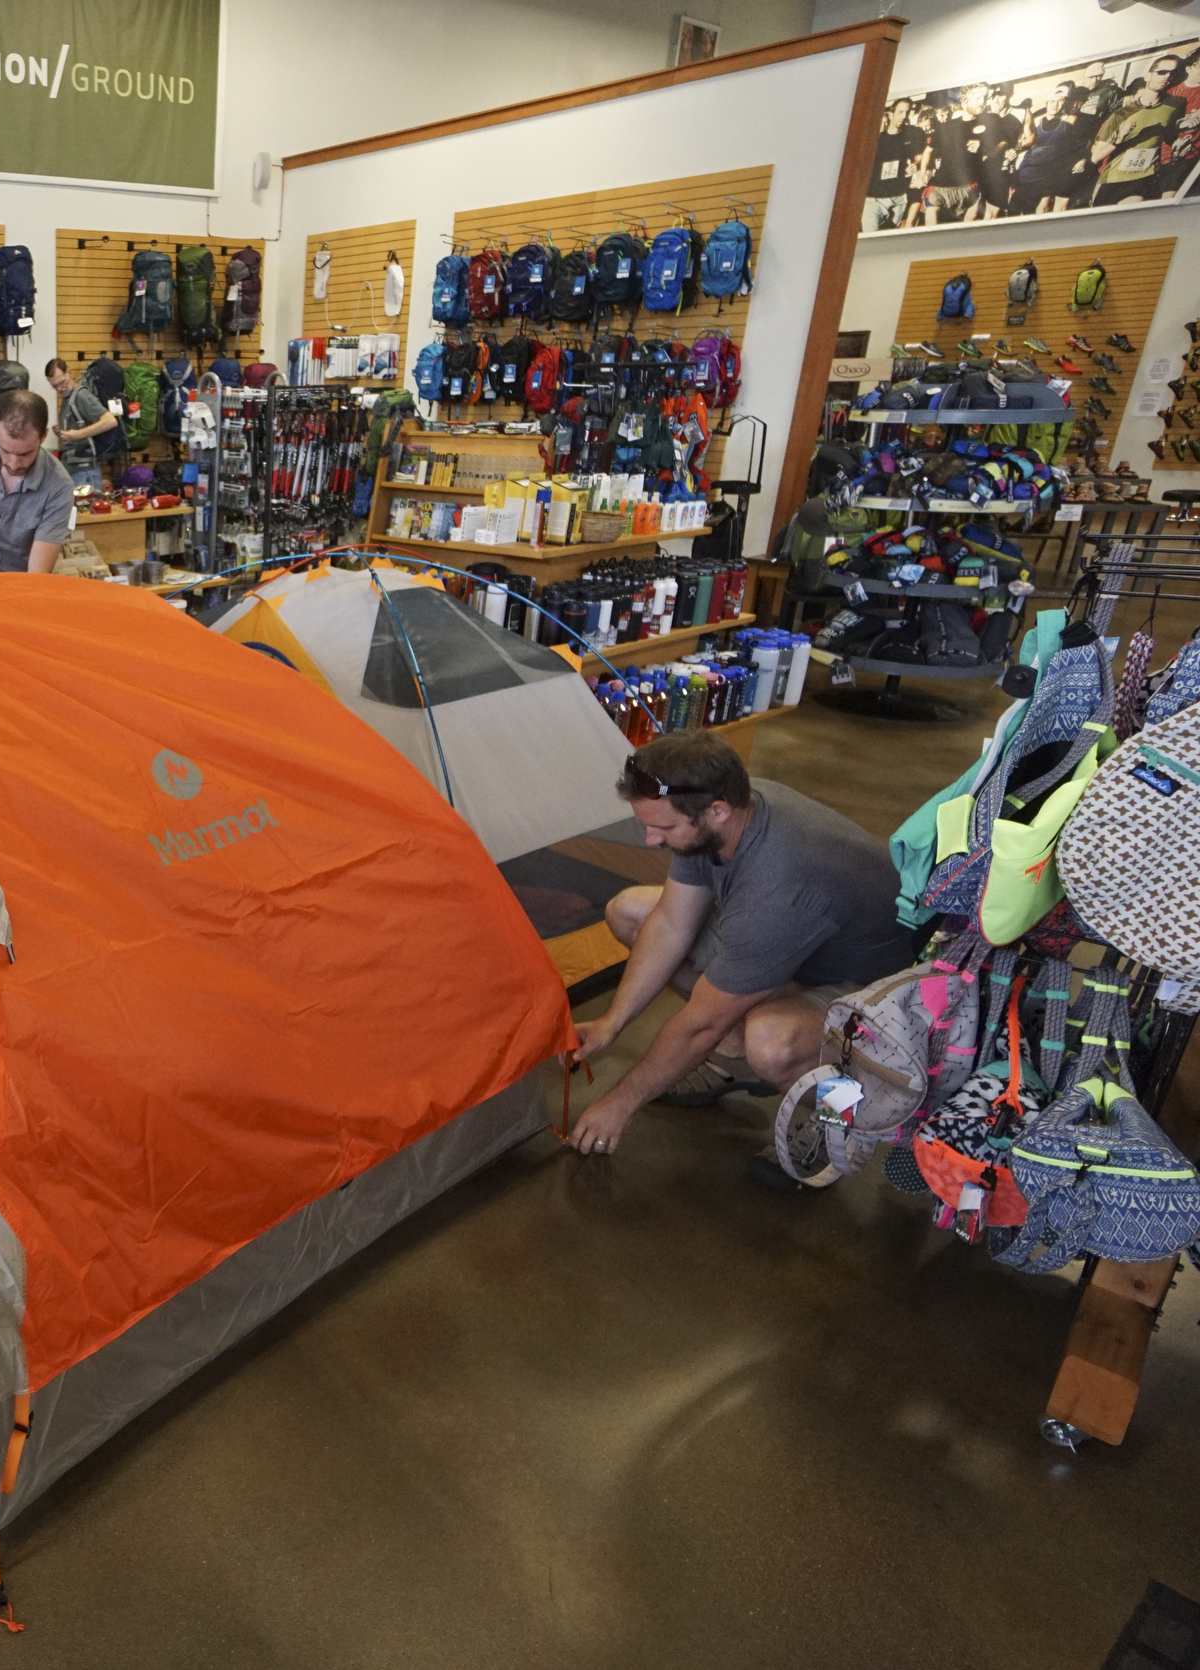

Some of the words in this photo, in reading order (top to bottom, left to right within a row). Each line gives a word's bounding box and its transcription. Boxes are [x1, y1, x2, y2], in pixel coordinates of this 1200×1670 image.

[71, 63, 195, 104] GROUND
[1126, 158, 1146, 168] 348
[836, 364, 867, 374] Chaco
[1140, 771, 1168, 792] KAVU
[147, 798, 280, 867] Marmot
[819, 1115, 848, 1126] KAVU
